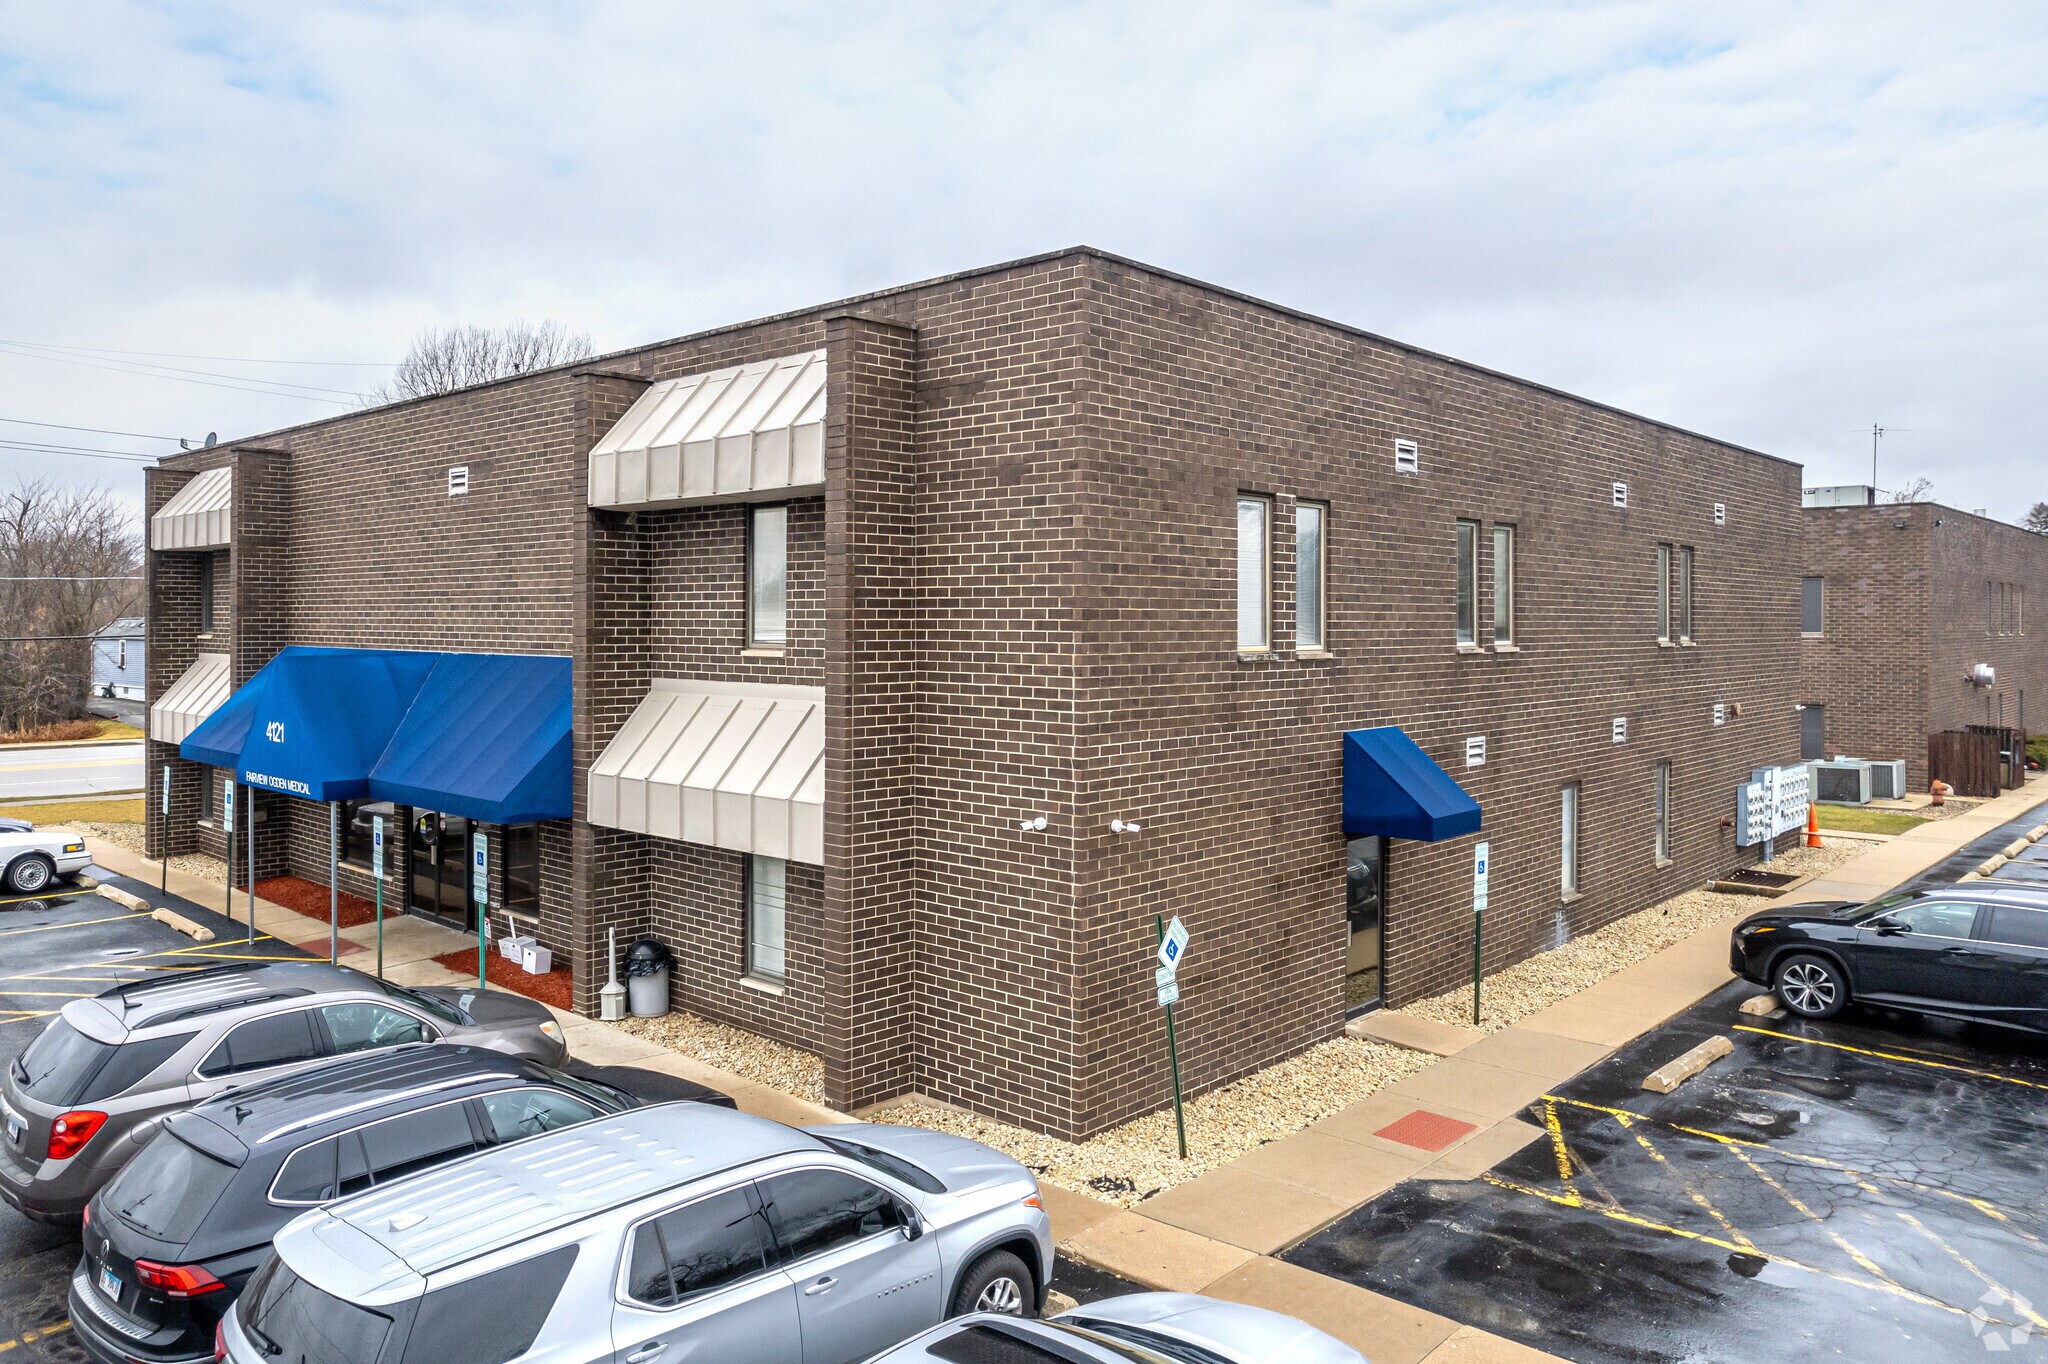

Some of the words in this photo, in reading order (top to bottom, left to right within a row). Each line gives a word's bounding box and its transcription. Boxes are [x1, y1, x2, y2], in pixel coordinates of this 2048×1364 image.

[266, 721, 284, 743] 4121
[246, 771, 268, 785] FAIRVIEW
[268, 776, 287, 789] OGDEN
[287, 780, 311, 795] MEDICAL
